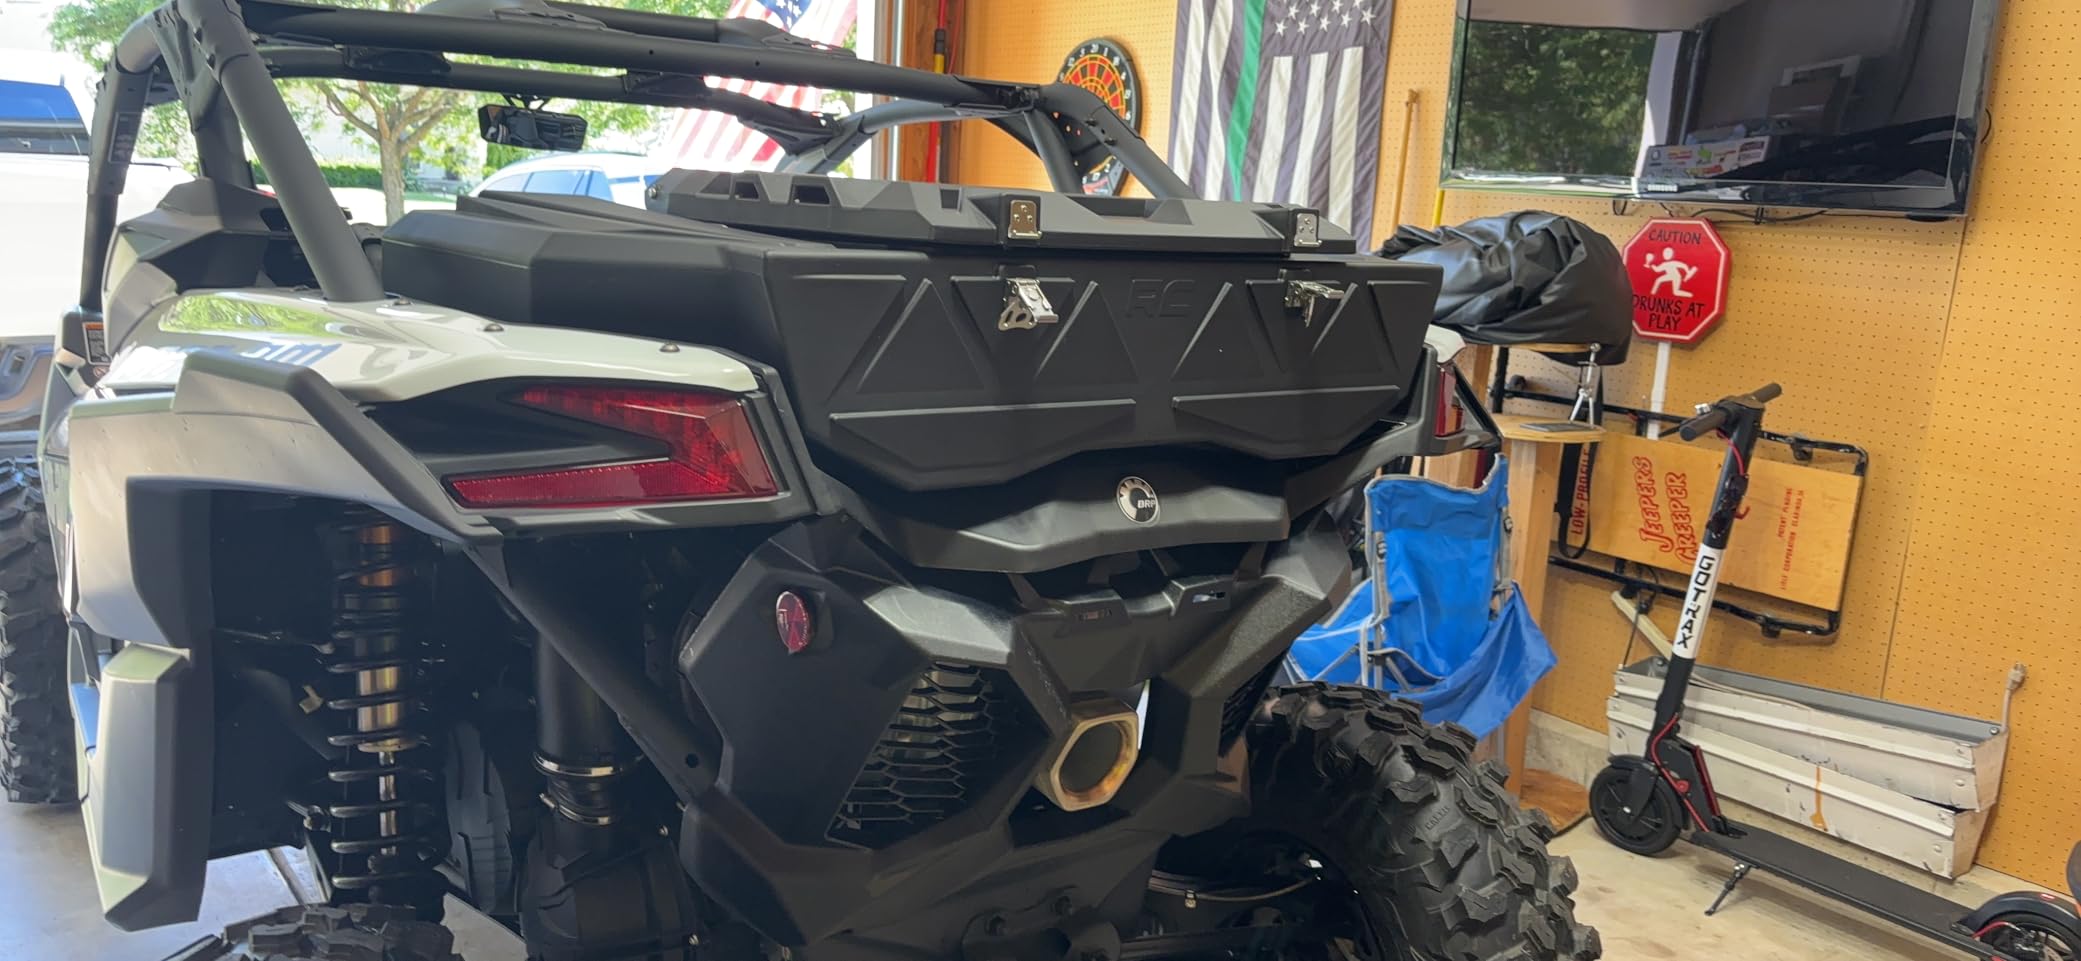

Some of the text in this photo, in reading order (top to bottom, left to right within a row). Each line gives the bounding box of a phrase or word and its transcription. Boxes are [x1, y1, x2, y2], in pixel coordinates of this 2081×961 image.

[1648, 229, 1702, 244] CAUTION
[1632, 294, 1705, 318] DRUNKS AT
[1648, 313, 1682, 331] PLAY
[1632, 456, 1674, 553] JEEPERS
[1676, 555, 1715, 649] GOTRAX
